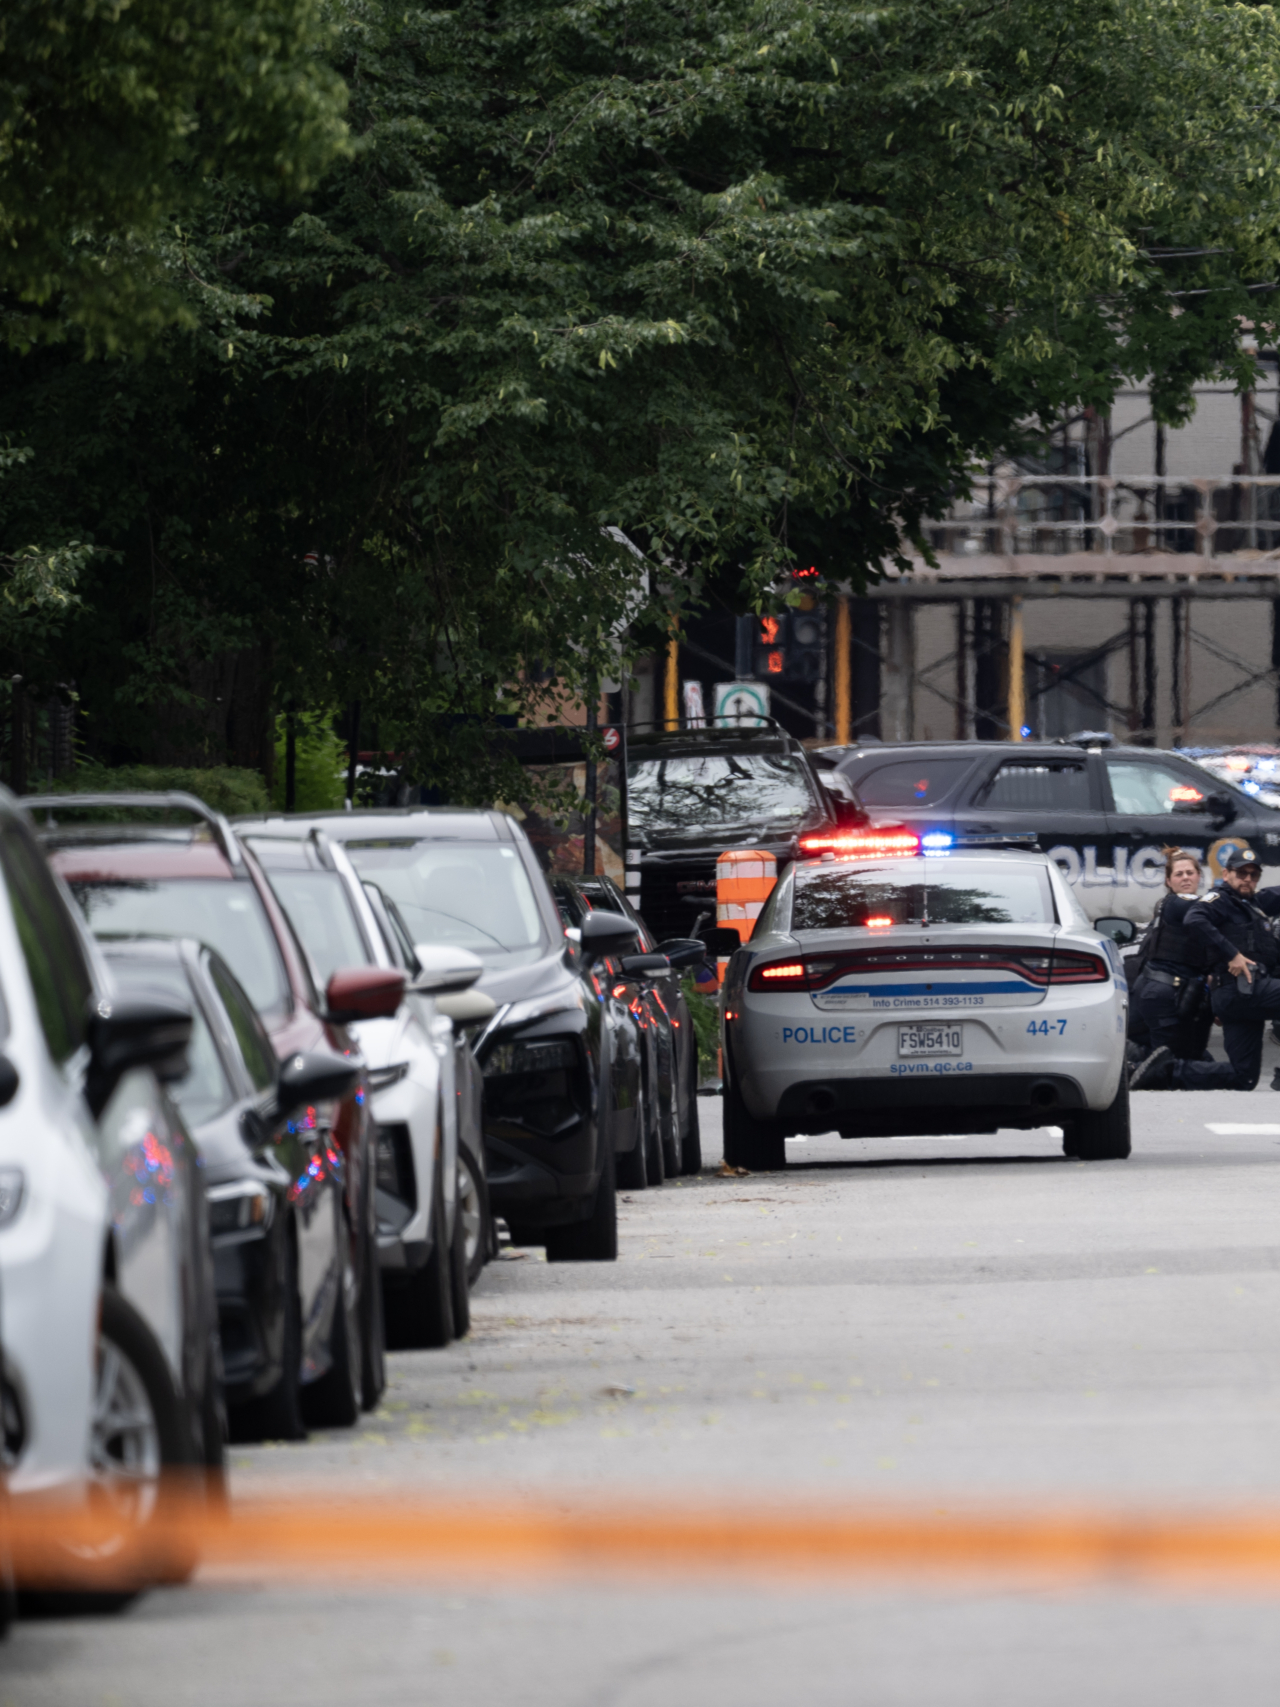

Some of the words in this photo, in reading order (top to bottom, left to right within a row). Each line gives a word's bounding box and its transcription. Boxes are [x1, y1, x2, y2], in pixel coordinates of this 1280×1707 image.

[1047, 844, 1203, 888] OLIC
[676, 879, 718, 894] GM
[873, 999, 891, 1008] Info
[893, 998, 921, 1007] Crime
[923, 997, 940, 1006] 514
[942, 997, 984, 1006] 393-1133
[782, 1027, 856, 1044] POLICE
[1026, 1020, 1067, 1036] 44-7
[901, 1032, 960, 1049] FSW5410
[890, 1062, 973, 1075] spvm.qc.ca
